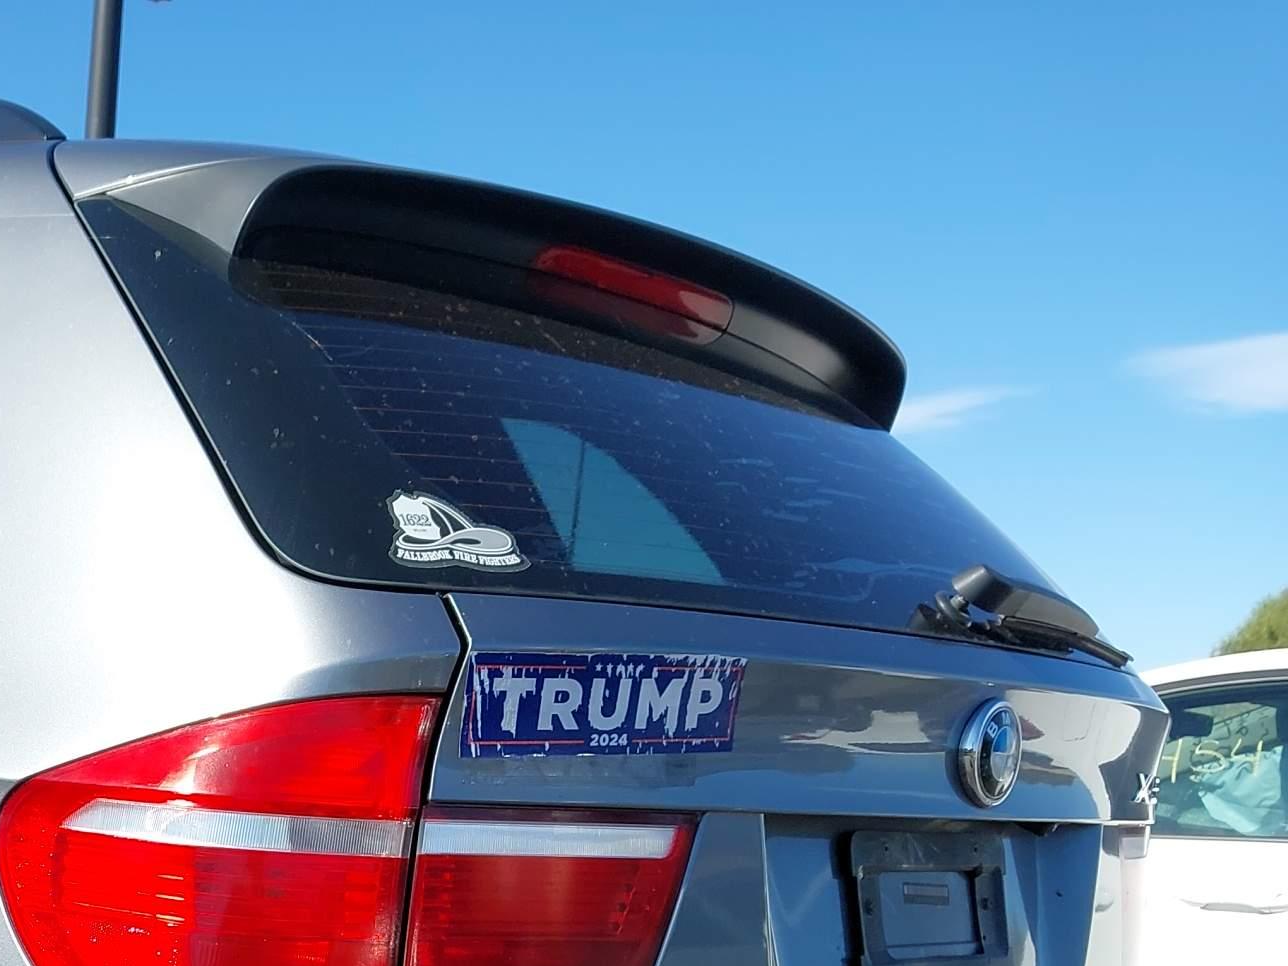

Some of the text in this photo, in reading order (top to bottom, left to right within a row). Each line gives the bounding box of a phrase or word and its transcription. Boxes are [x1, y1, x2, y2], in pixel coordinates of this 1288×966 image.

[399, 513, 432, 526] 1622
[397, 548, 521, 566] FALLBROOK FIRE FIGHTERS
[492, 676, 724, 734] TRUMP
[589, 733, 629, 747] 2024
